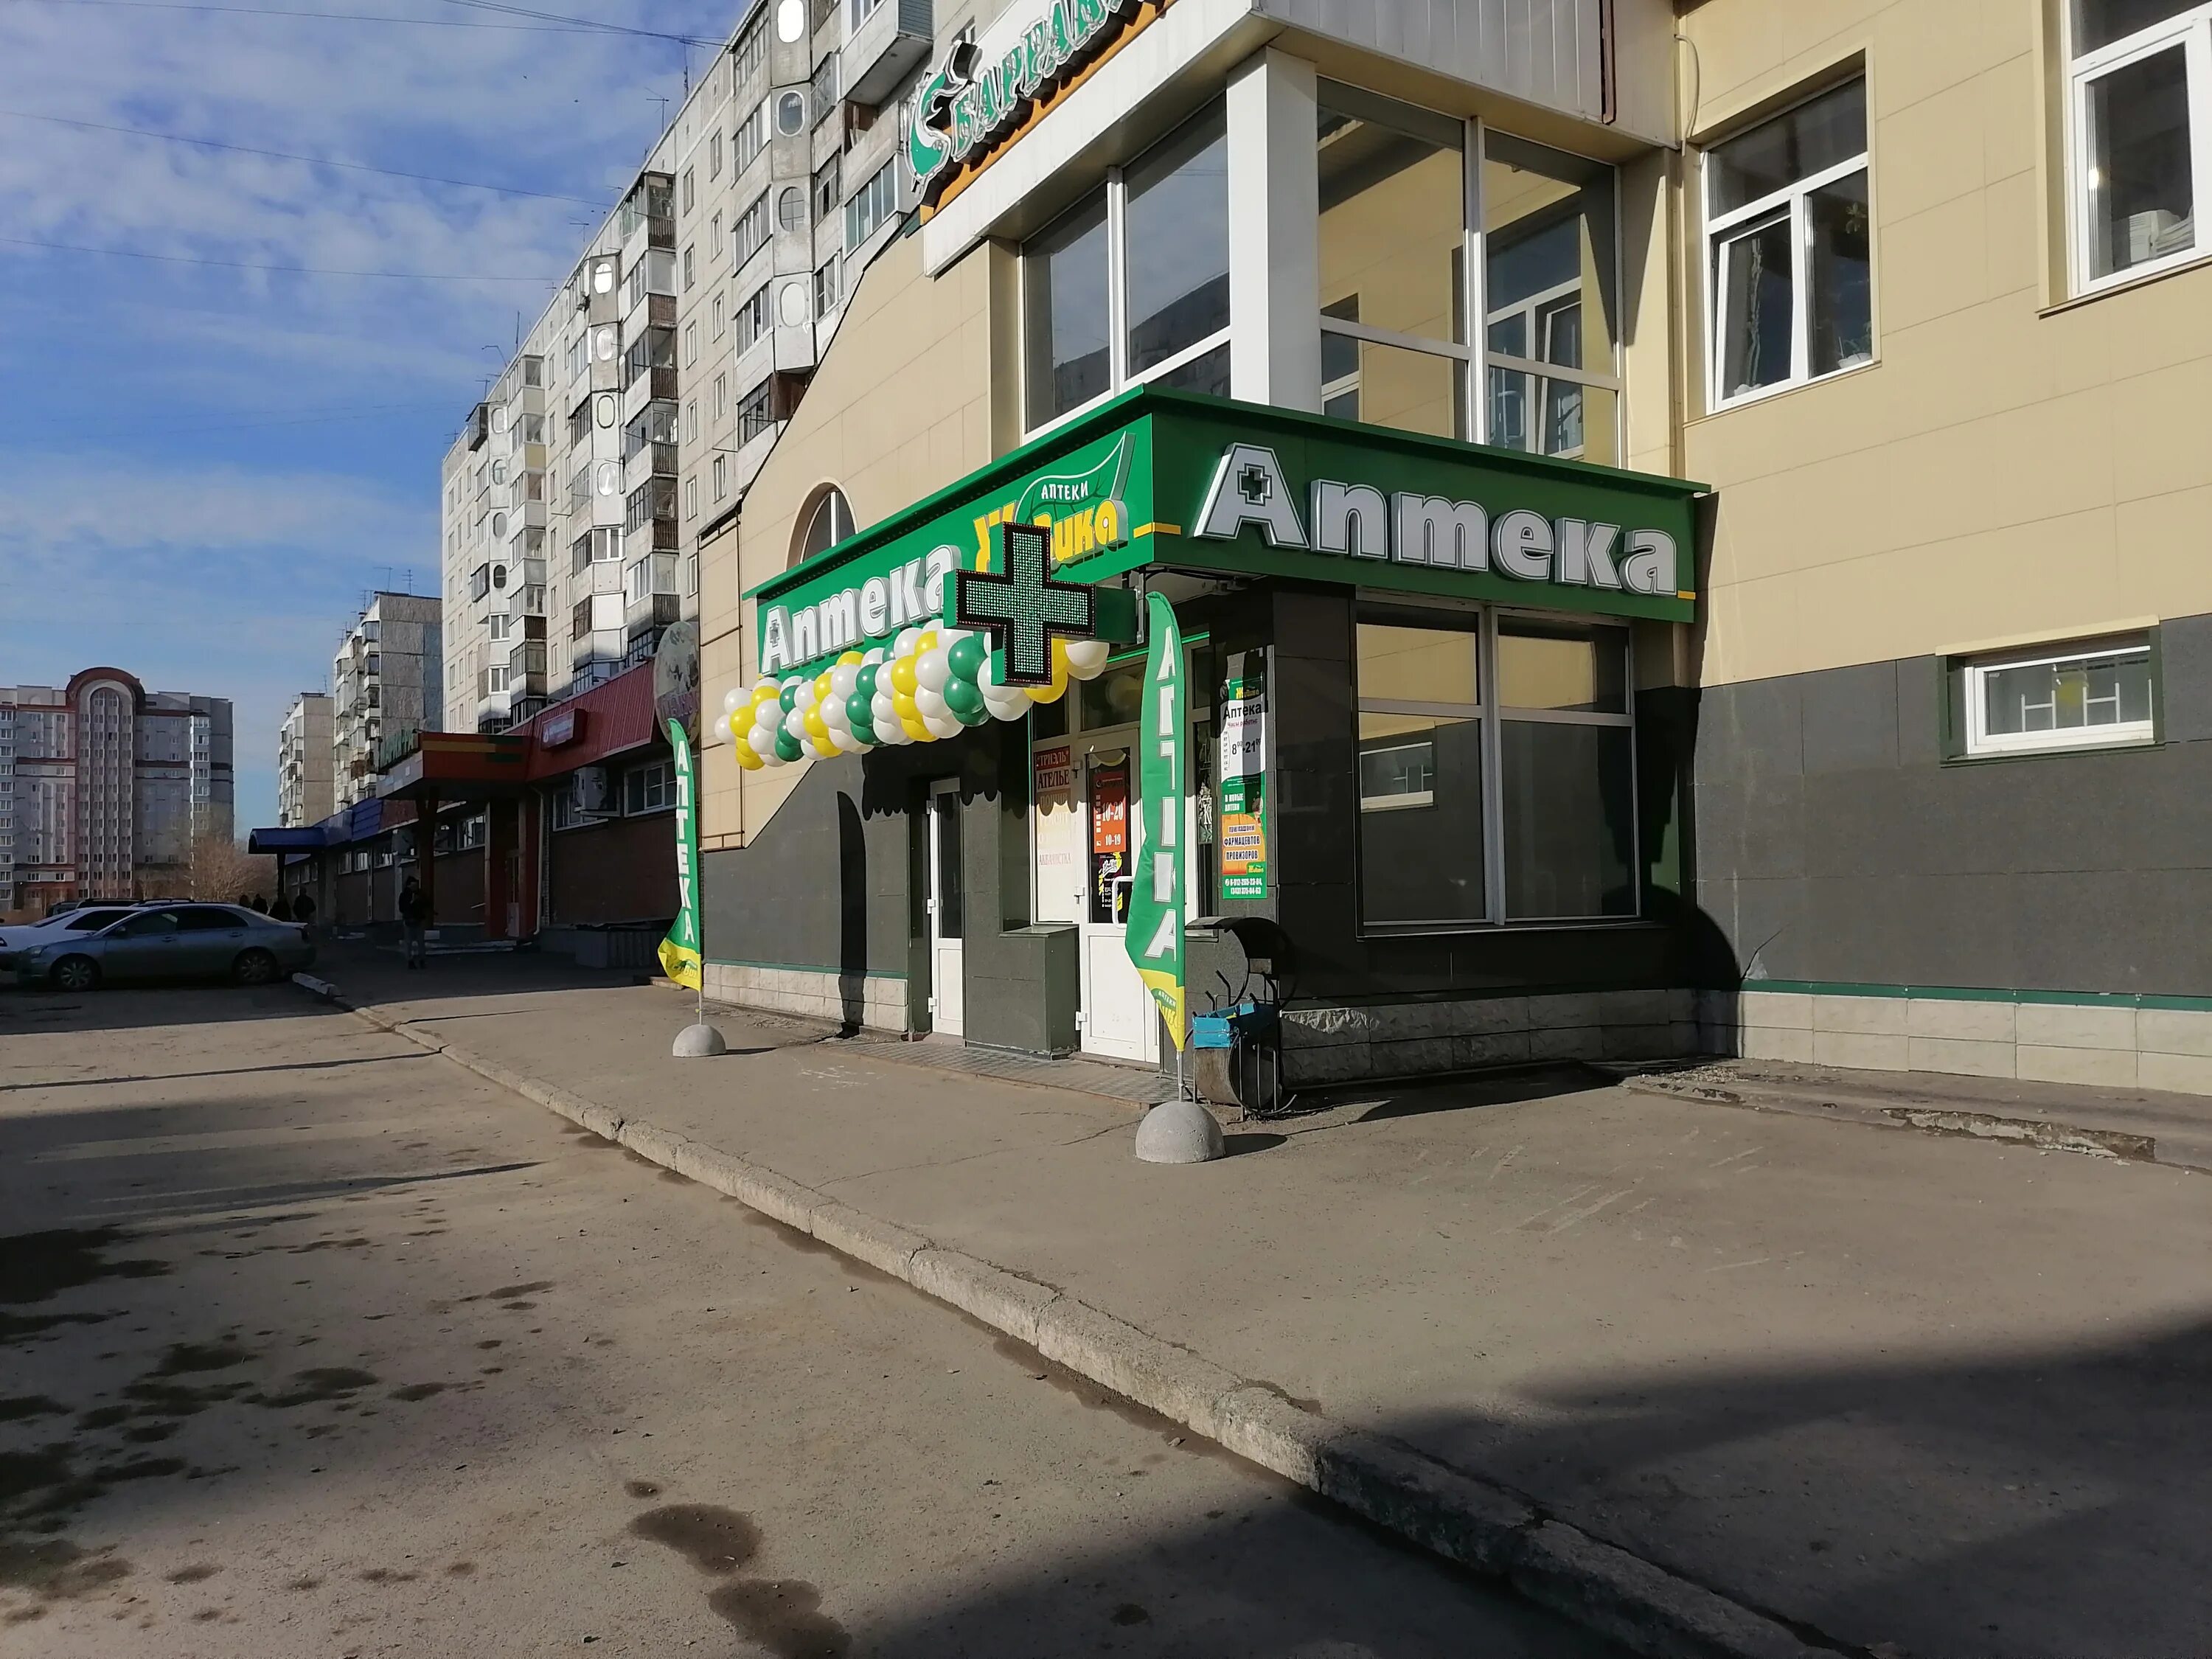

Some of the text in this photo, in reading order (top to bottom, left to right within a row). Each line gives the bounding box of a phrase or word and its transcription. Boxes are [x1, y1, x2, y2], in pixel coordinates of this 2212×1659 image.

[1041, 481, 1089, 501] АПТЕКИ
[1194, 442, 1677, 597] Аптека
[761, 544, 960, 677] Аптека
[1222, 703, 1262, 720] Аптека
[1038, 769, 1070, 790] АТЕЛЬЕ
[1102, 801, 1124, 822] 10-20
[676, 740, 695, 944] АПТЕКА
[1105, 833, 1121, 846] 10-19
[1223, 835, 1260, 847] ФАРМАЦЕВТОВ
[1226, 850, 1258, 860] ПРОВИЗОРОВ
